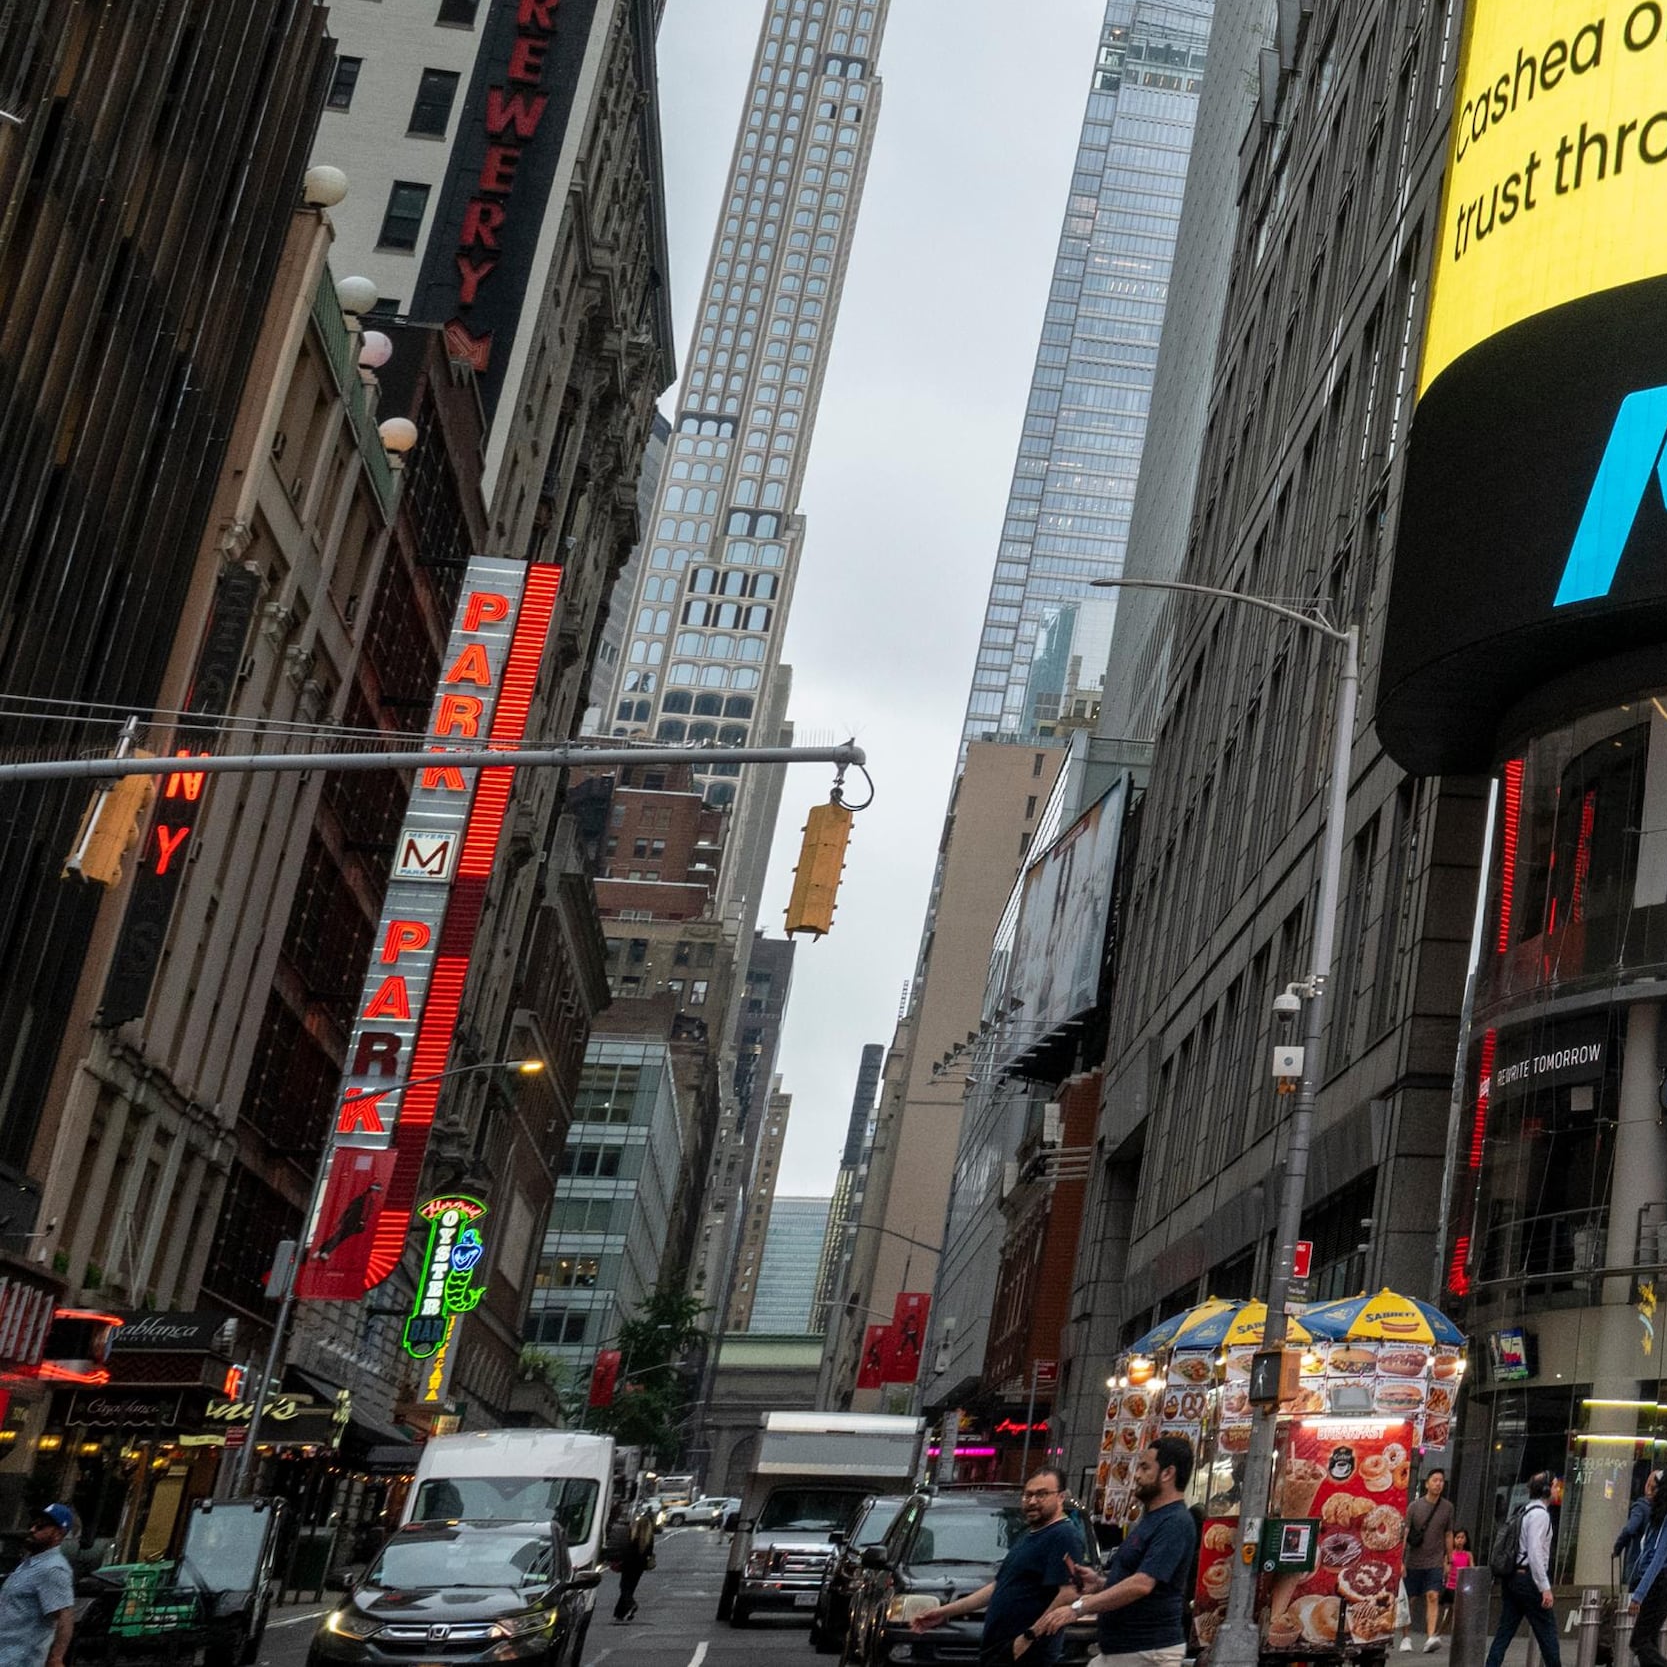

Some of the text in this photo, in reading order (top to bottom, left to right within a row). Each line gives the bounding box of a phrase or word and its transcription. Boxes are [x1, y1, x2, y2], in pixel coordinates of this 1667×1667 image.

[1455, 17, 1605, 164] cashea
[1452, 150, 1540, 263] trust
[421, 592, 510, 791] PARK
[337, 920, 431, 1135] PARK
[1533, 1043, 1601, 1074] TOMORROW
[421, 1209, 458, 1316] OYSTER
